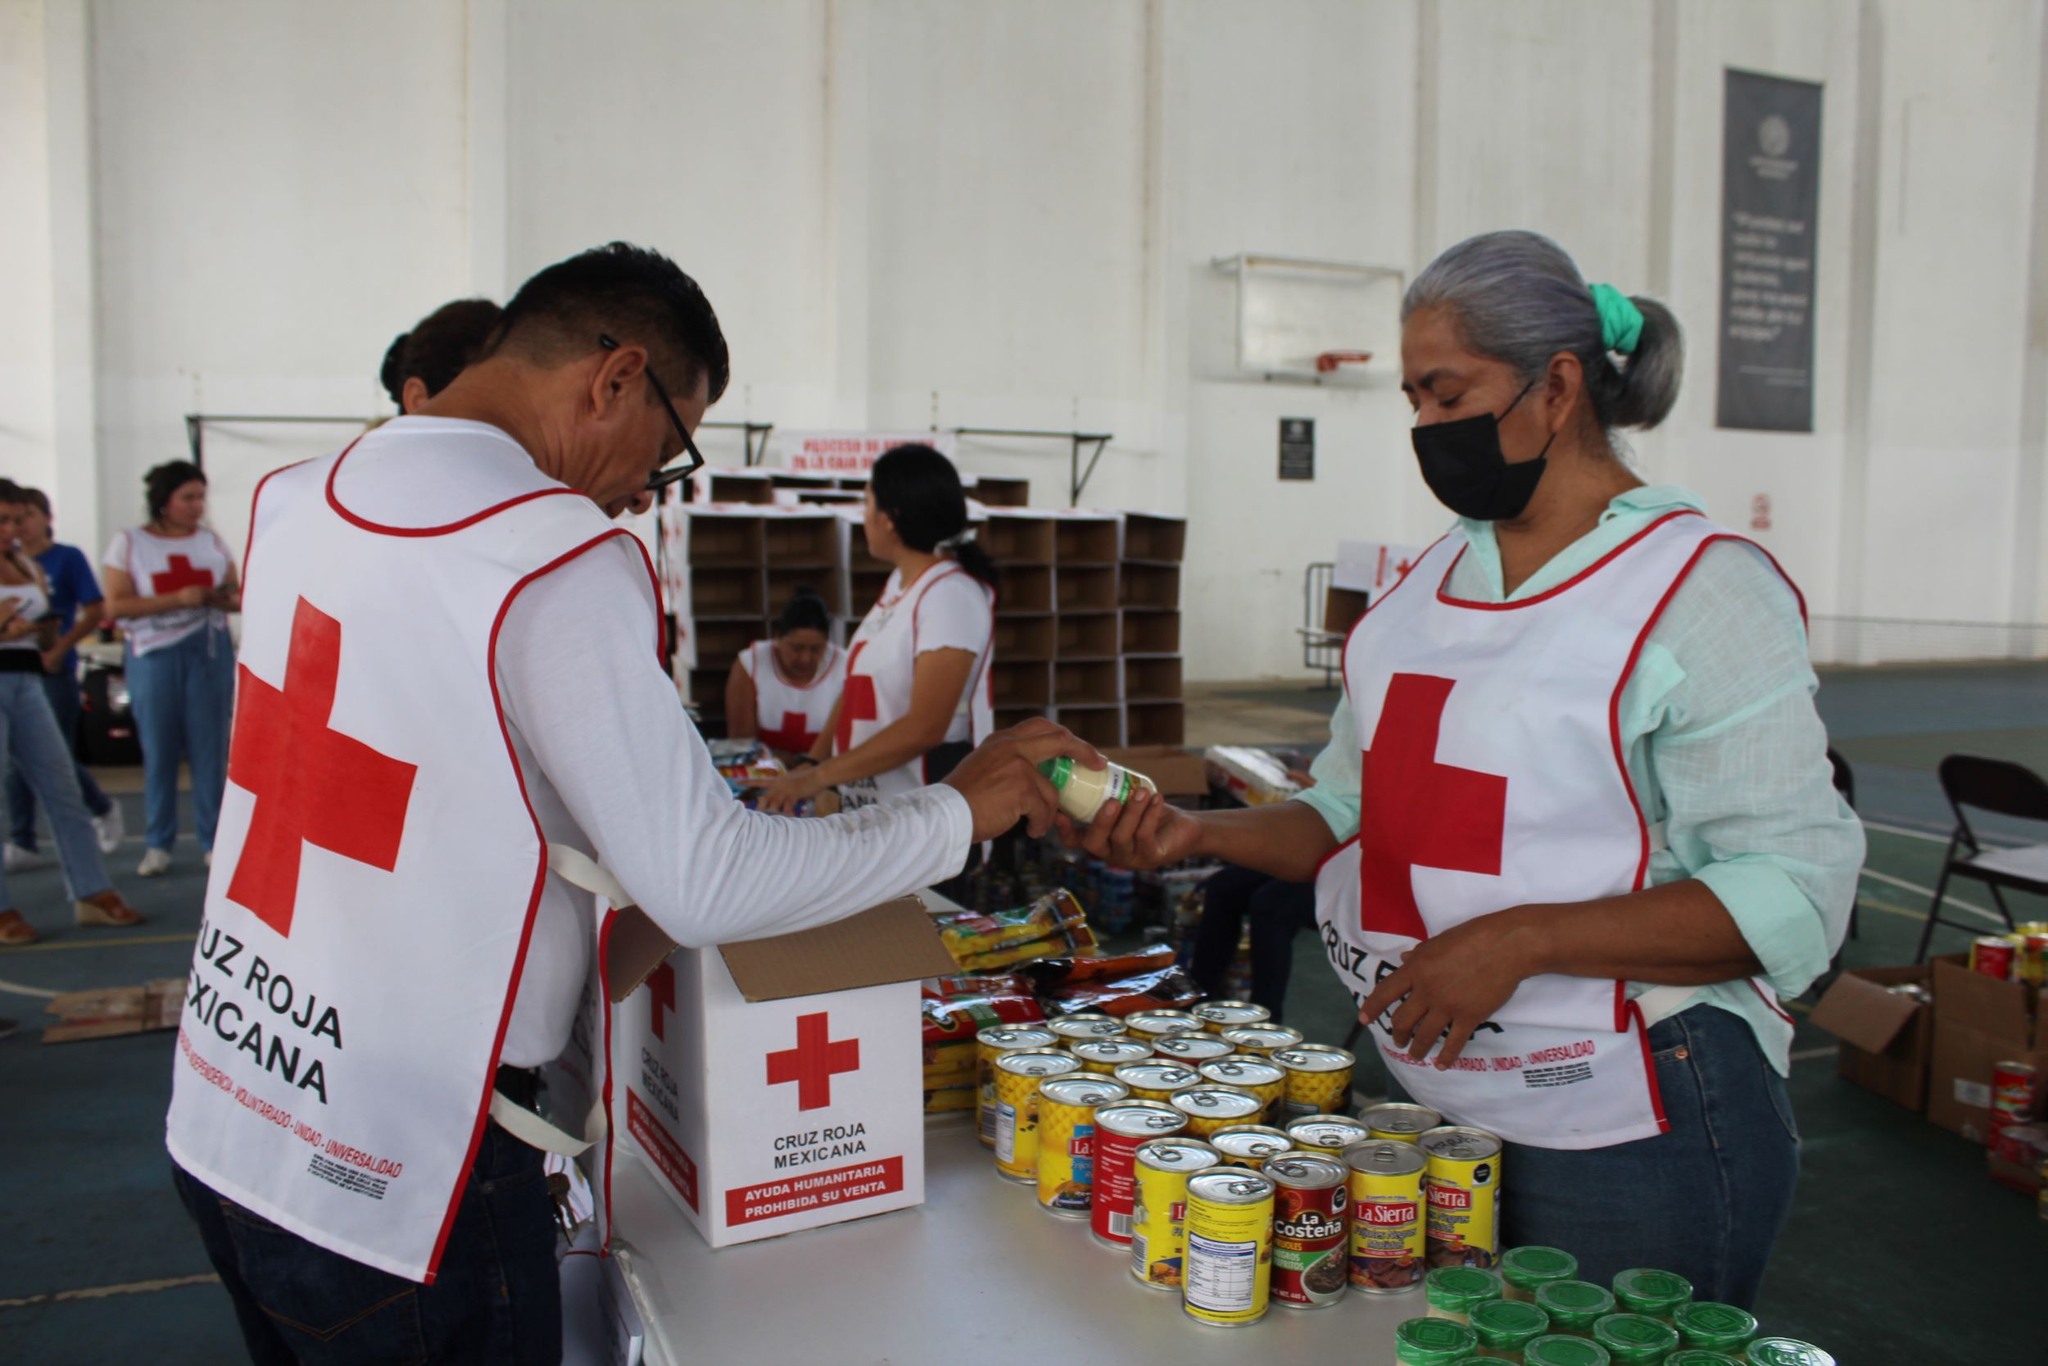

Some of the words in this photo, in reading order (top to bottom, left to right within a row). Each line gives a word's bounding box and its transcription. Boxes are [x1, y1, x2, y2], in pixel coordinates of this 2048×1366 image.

[200, 920, 244, 977] UZ
[244, 955, 342, 1049] ROJA
[188, 972, 327, 1105] XICANA
[1527, 1040, 1595, 1065] UNIVERSALIDAD
[235, 1088, 291, 1129] VOLUNTARIADO
[294, 1120, 322, 1148] UNIDAD
[325, 1139, 403, 1178] UNIVERSALIDAD
[774, 1126, 819, 1151] CRUZ
[822, 1122, 866, 1142] ROJA
[774, 1140, 866, 1169] MEXICANA
[745, 1184, 790, 1202] AYUDA
[794, 1164, 885, 1192] HUMANITARIA
[1428, 1184, 1467, 1207] Sierra
[745, 1195, 818, 1219] PROHIBIDA
[821, 1190, 840, 1202] SU
[843, 1180, 886, 1198] VENTA
[1177, 1205, 1185, 1220] L
[1358, 1205, 1373, 1221] La
[1374, 1205, 1414, 1223] Sierra
[1275, 1220, 1342, 1238] Costeña
[1302, 1213, 1319, 1225] La
